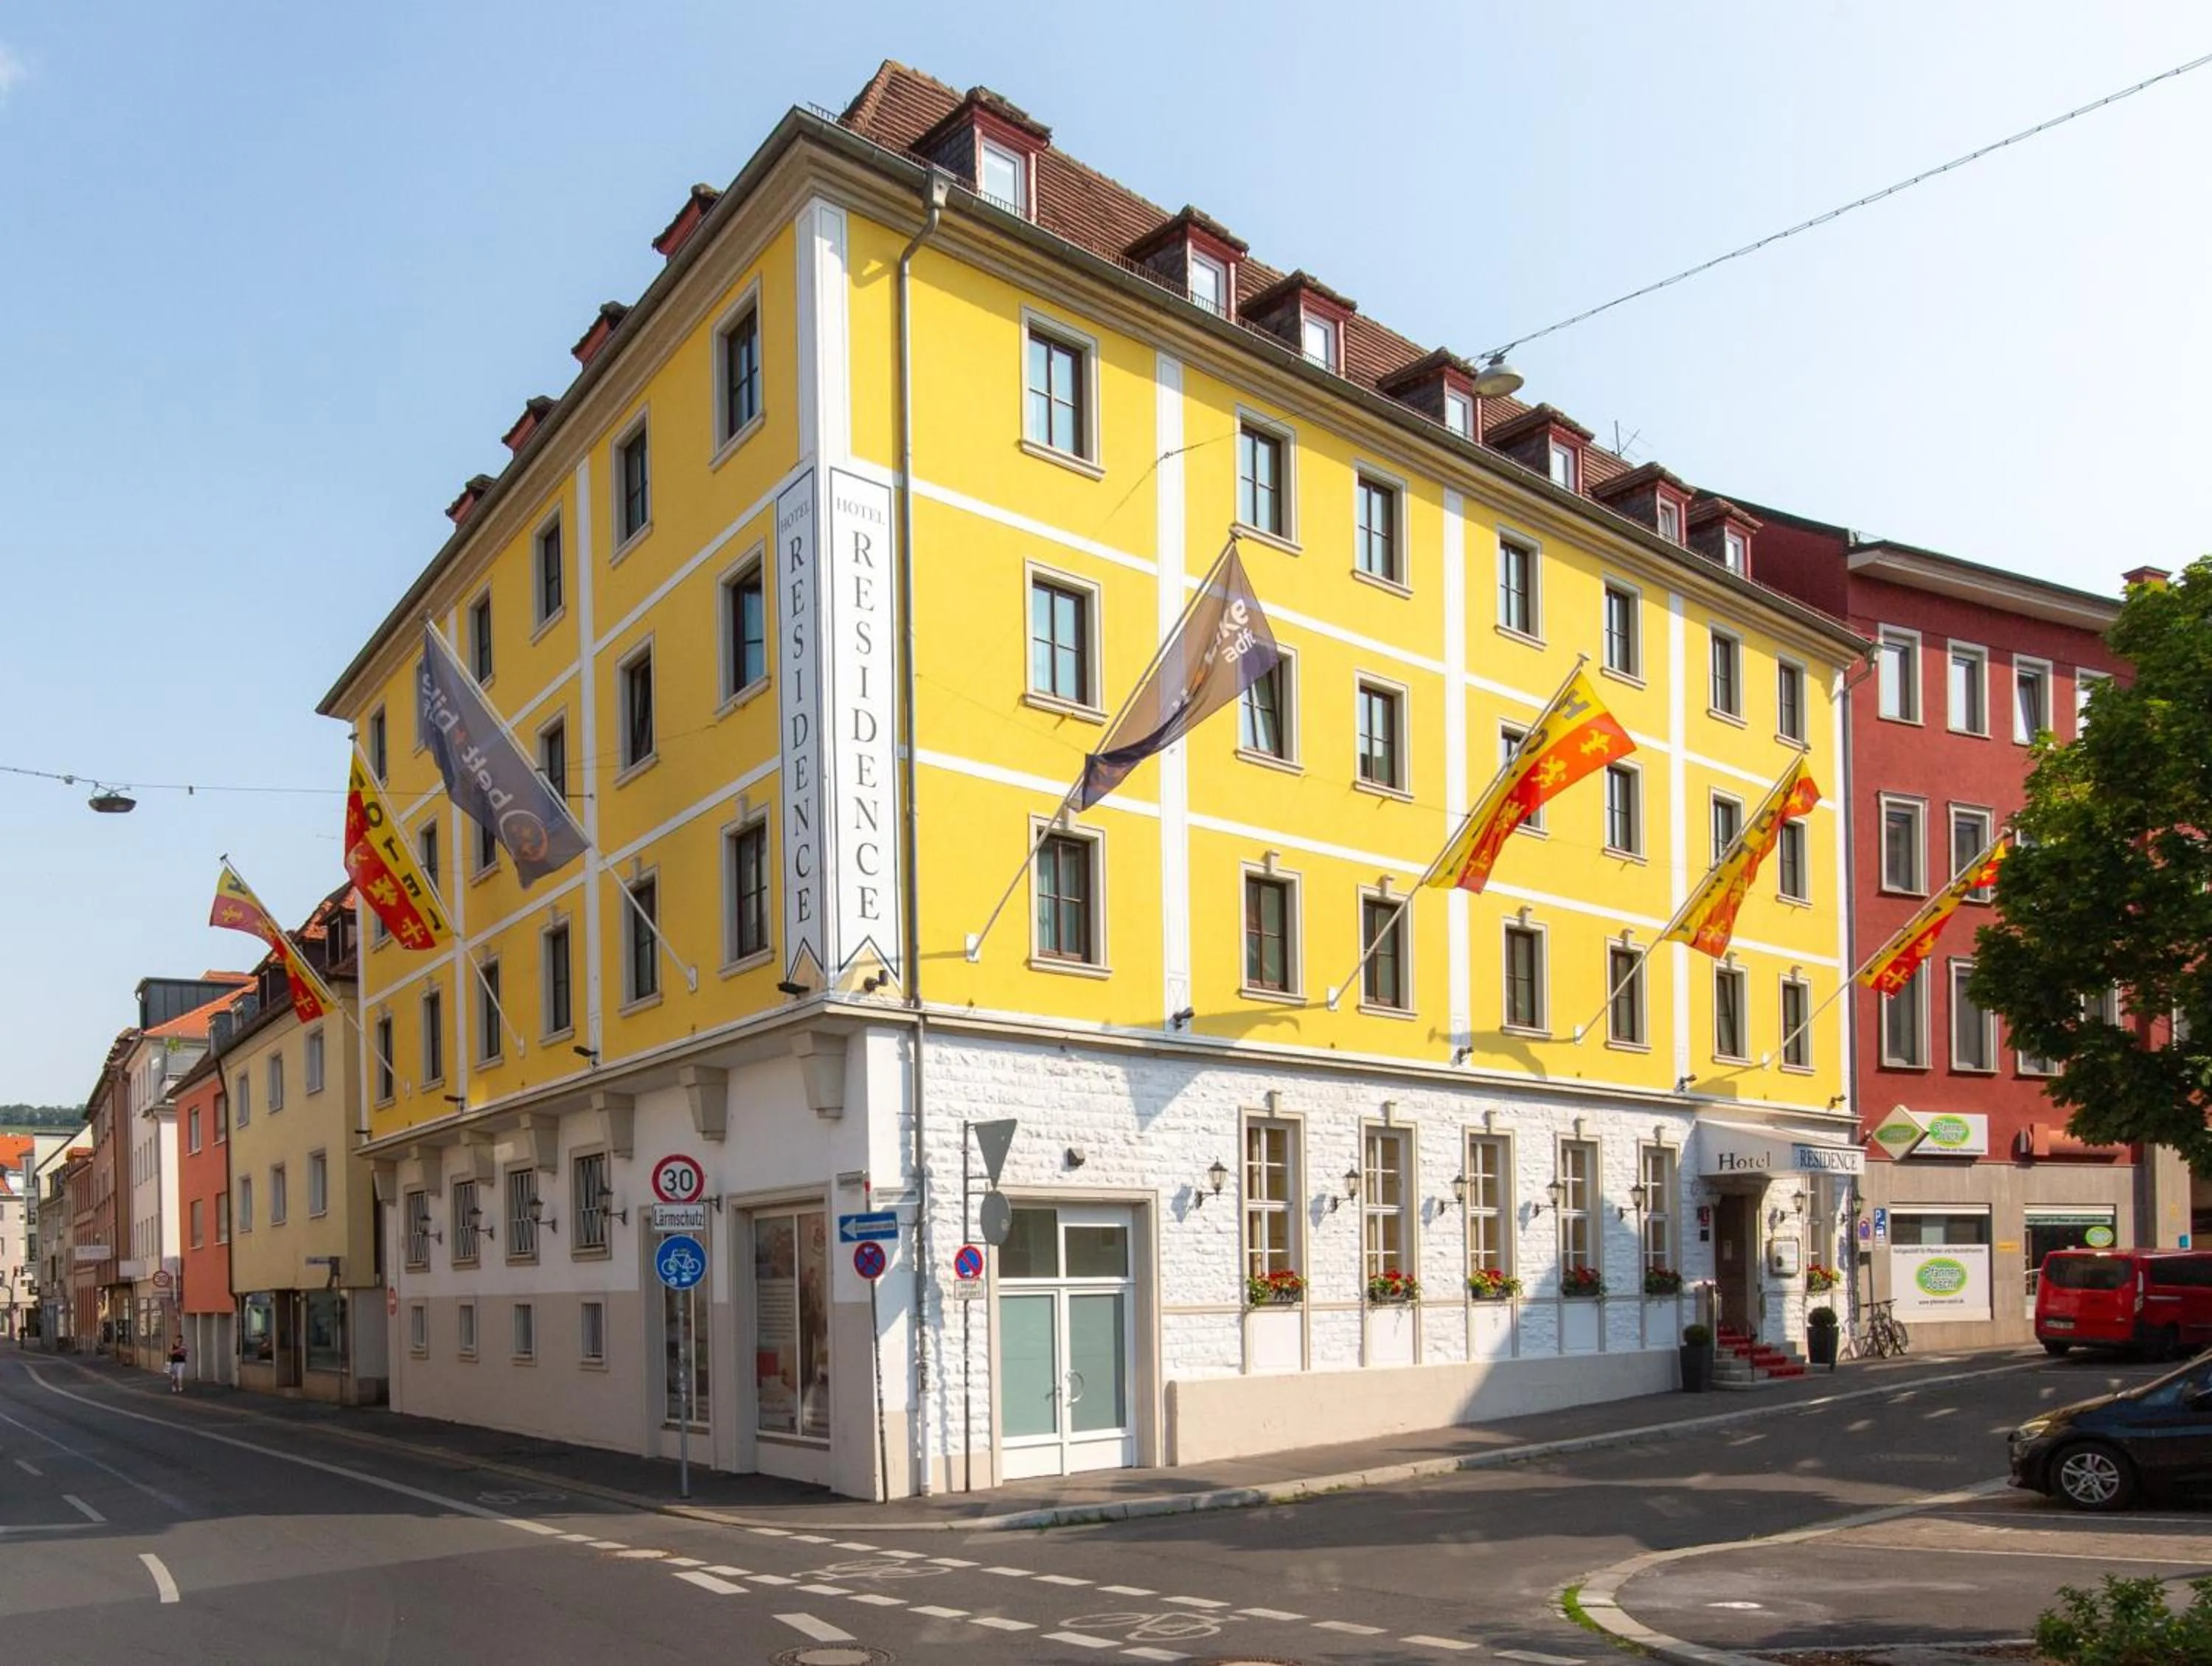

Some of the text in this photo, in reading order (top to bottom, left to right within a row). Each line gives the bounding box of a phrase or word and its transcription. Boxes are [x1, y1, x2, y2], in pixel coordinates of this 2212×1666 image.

[780, 501, 810, 534] HOTEL
[837, 497, 885, 526] HOTEL
[790, 536, 811, 923] RESIDENCE
[851, 530, 880, 921] RESIDENCE
[1717, 1151, 1770, 1171] Hotel
[1800, 1149, 1858, 1171] RESIDENCE
[664, 1168, 694, 1192] 30
[654, 1210, 703, 1227] Lärmschutz
